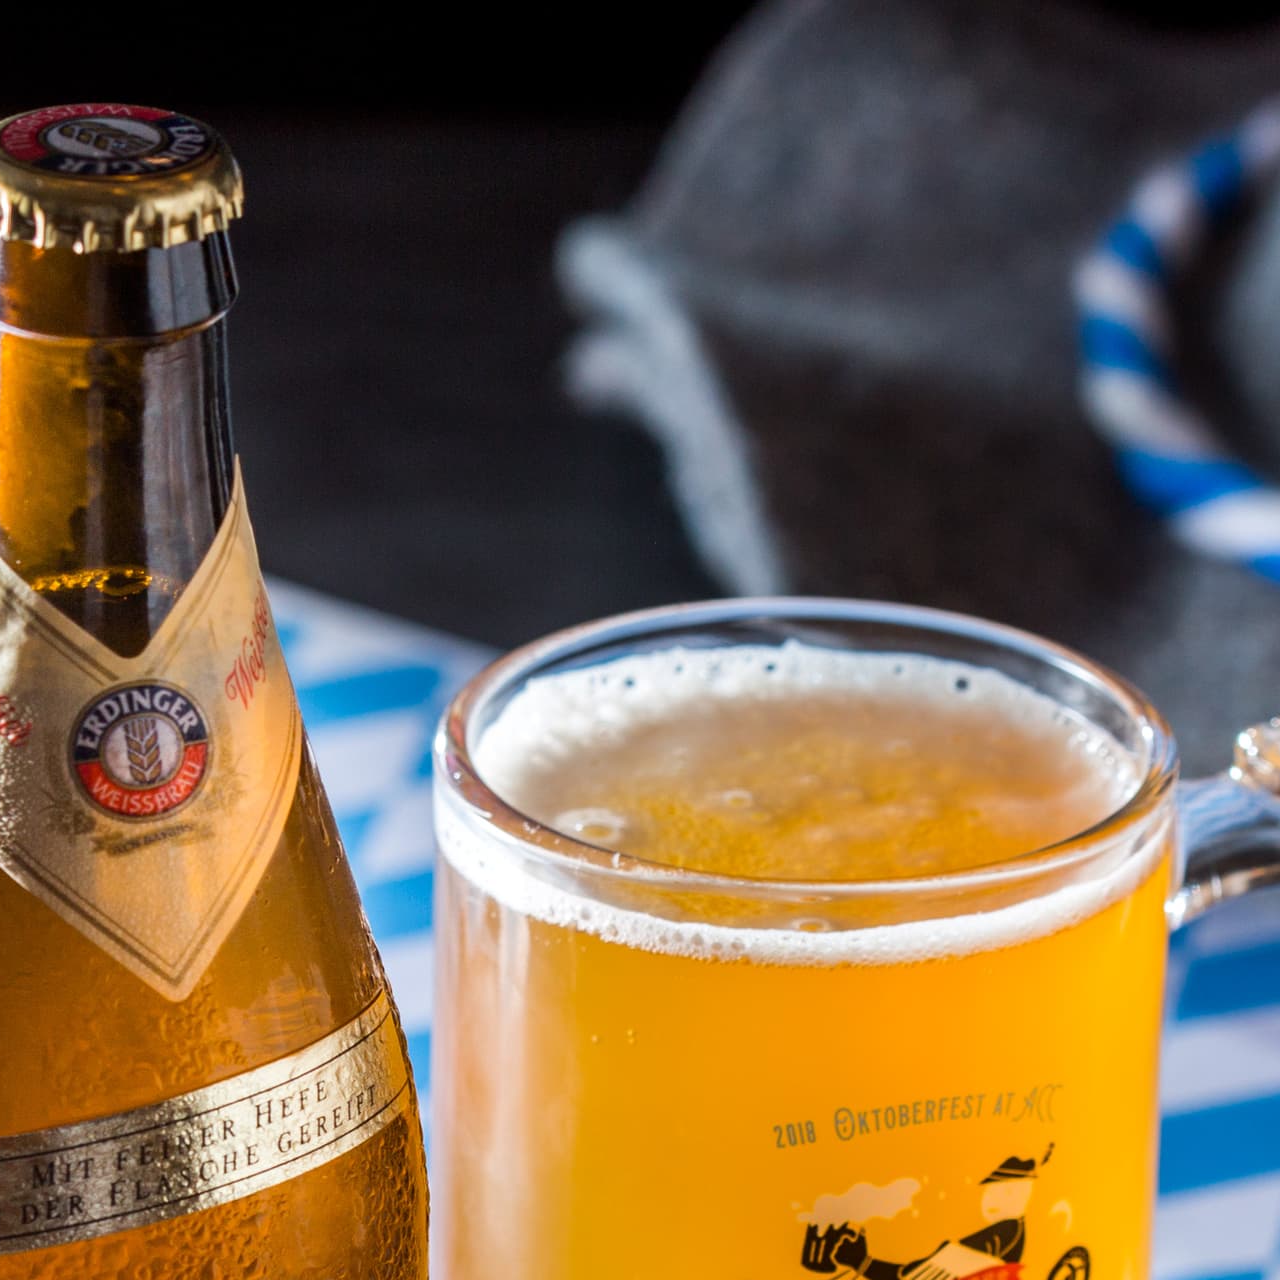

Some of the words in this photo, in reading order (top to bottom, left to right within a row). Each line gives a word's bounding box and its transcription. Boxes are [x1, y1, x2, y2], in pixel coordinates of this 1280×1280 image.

[77, 687, 199, 750] ERDINGER
[91, 760, 203, 814] WEISSBRÄU
[31, 1156, 96, 1191] MIT
[115, 1118, 236, 1172] FEINER
[255, 1079, 330, 1129] HEFE
[773, 1119, 817, 1149] 2018
[833, 1094, 987, 1142] OKTOBERFEST
[992, 1091, 1017, 1117] AT
[20, 1194, 85, 1226] DER
[109, 1143, 261, 1207] FLASCHE
[276, 1083, 377, 1154] GEREIFT
